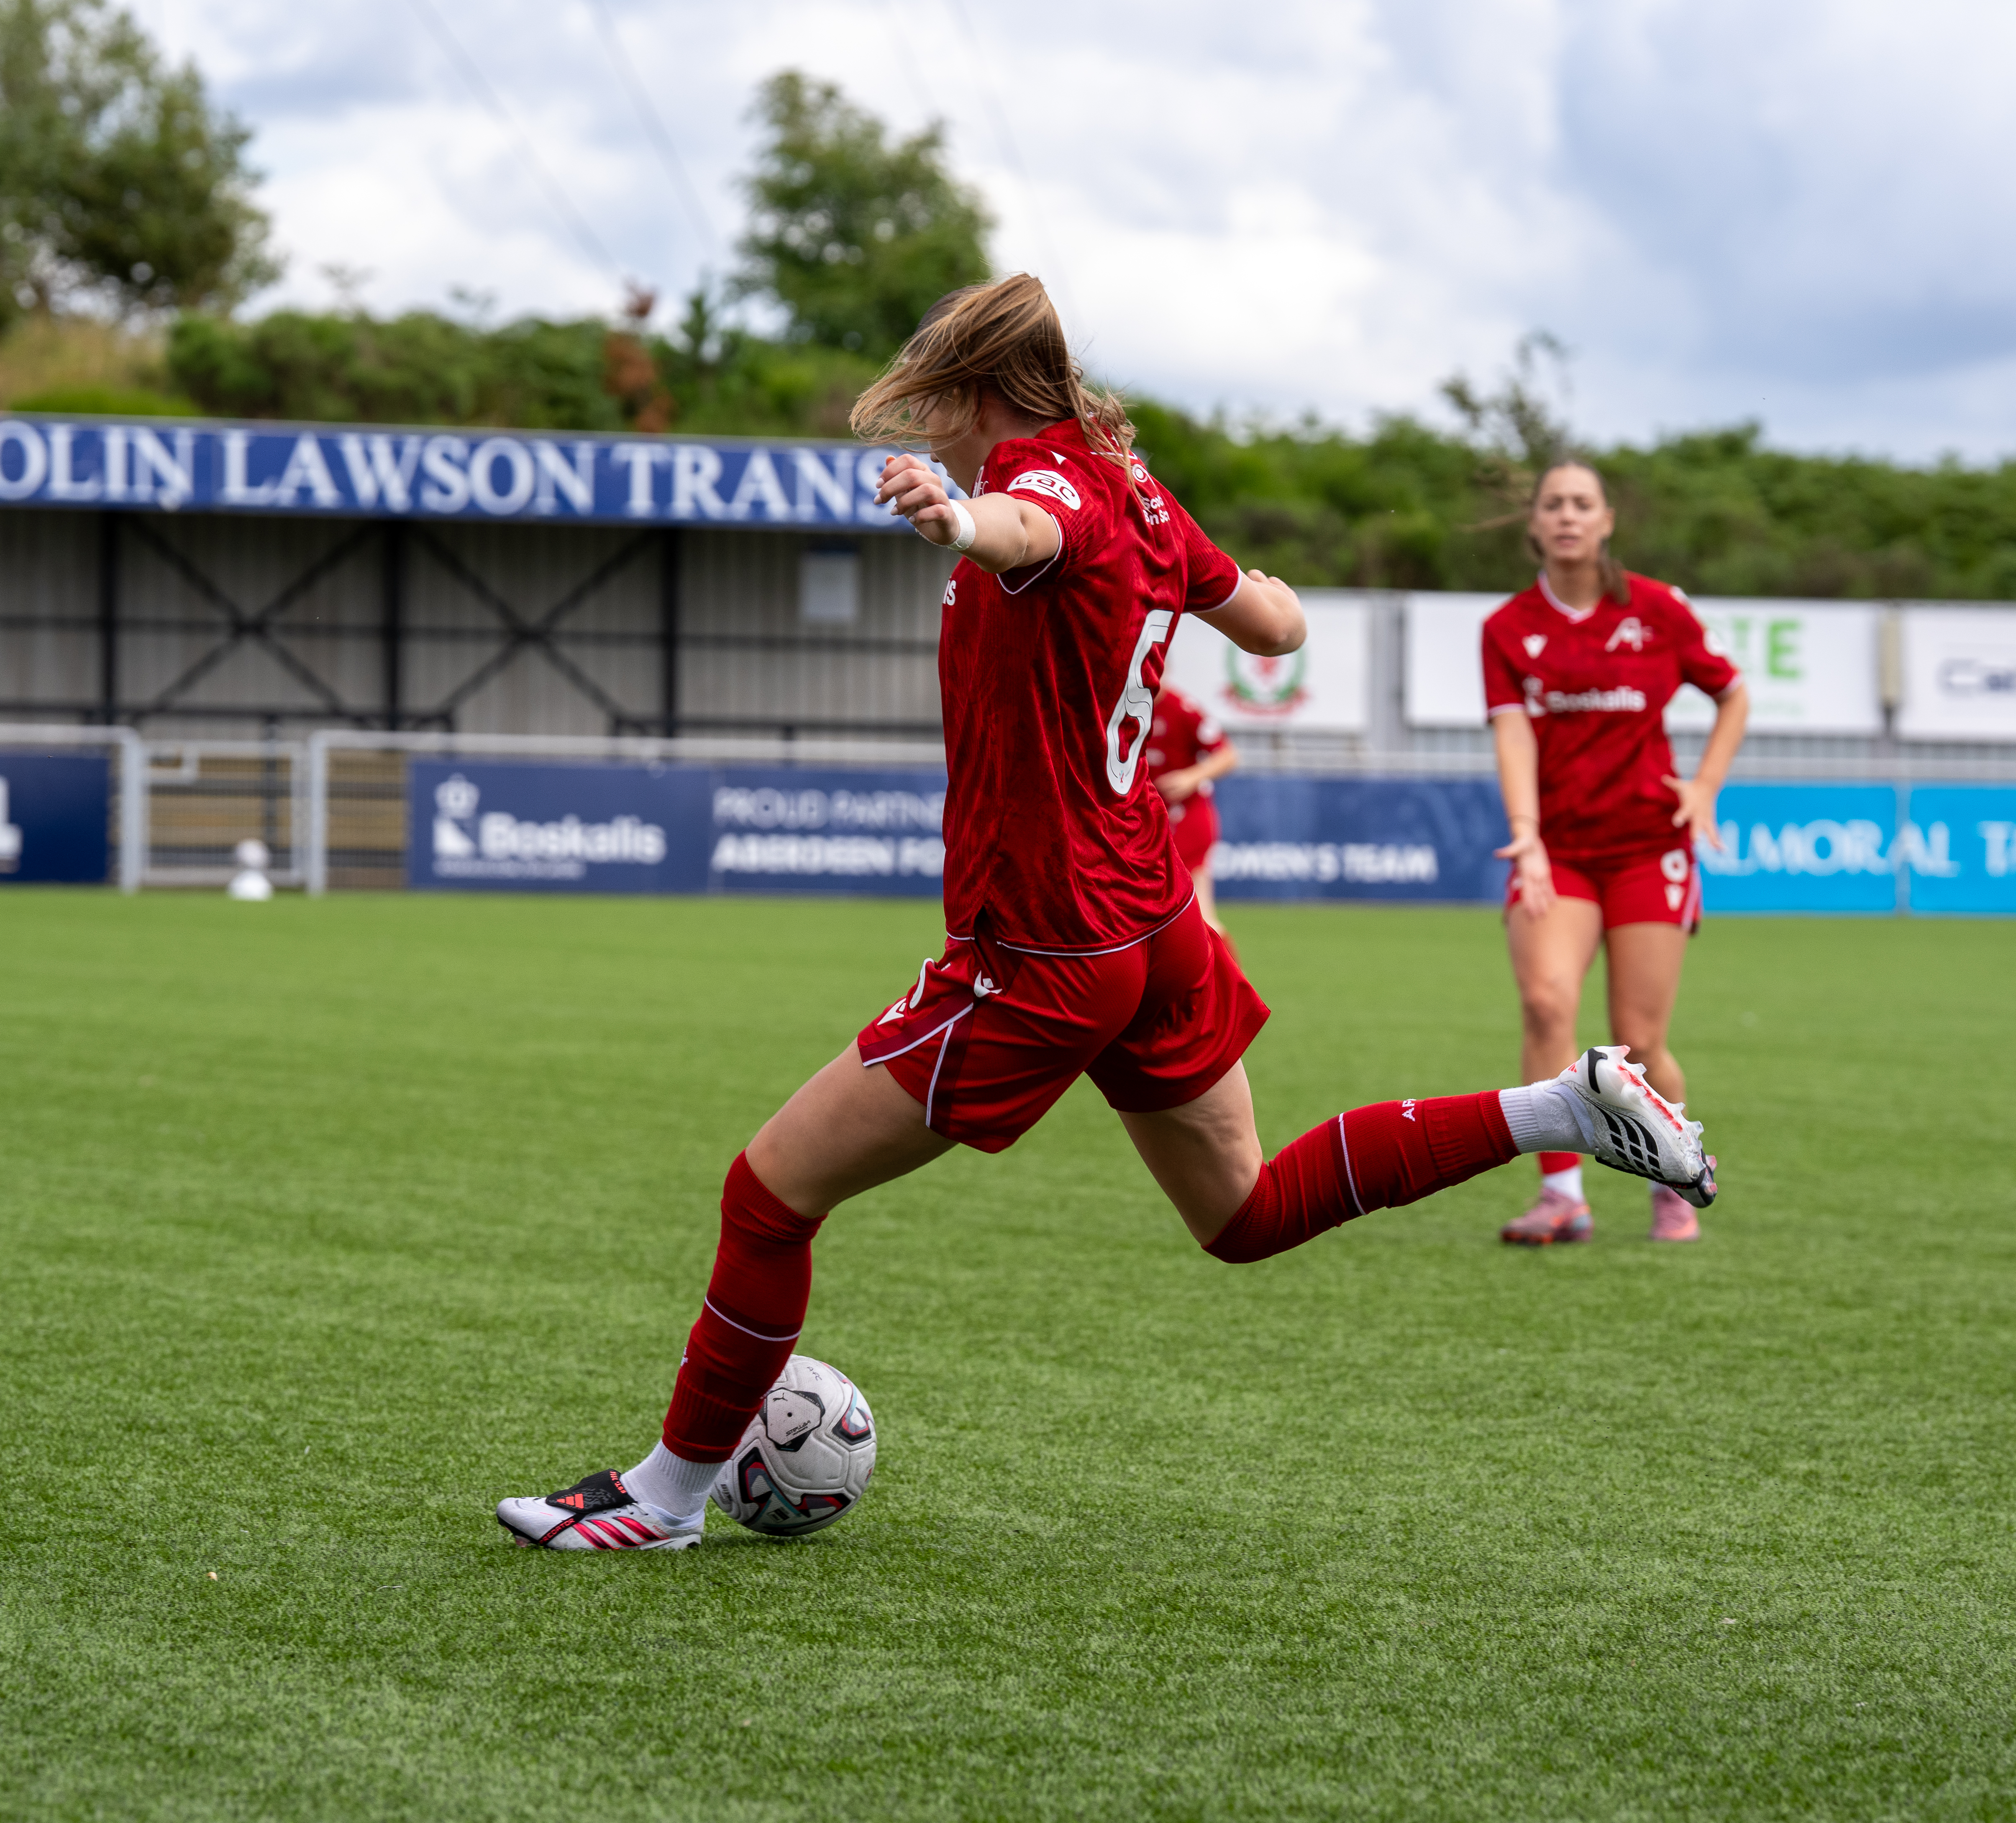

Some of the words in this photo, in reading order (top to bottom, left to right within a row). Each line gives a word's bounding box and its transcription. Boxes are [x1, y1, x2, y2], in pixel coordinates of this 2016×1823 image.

[219, 428, 595, 518] LAWSON
[1106, 609, 1174, 795] 6
[1547, 685, 1647, 713] Boskalis
[712, 786, 828, 830] PROUD
[479, 812, 666, 864] Boskalis
[712, 832, 894, 877] ABERDEEN
[1976, 820, 2016, 878] T
[1341, 841, 1439, 883] TEAM
[1401, 1098, 1417, 1121] AF
[539, 1518, 576, 1544] PREDATOR
